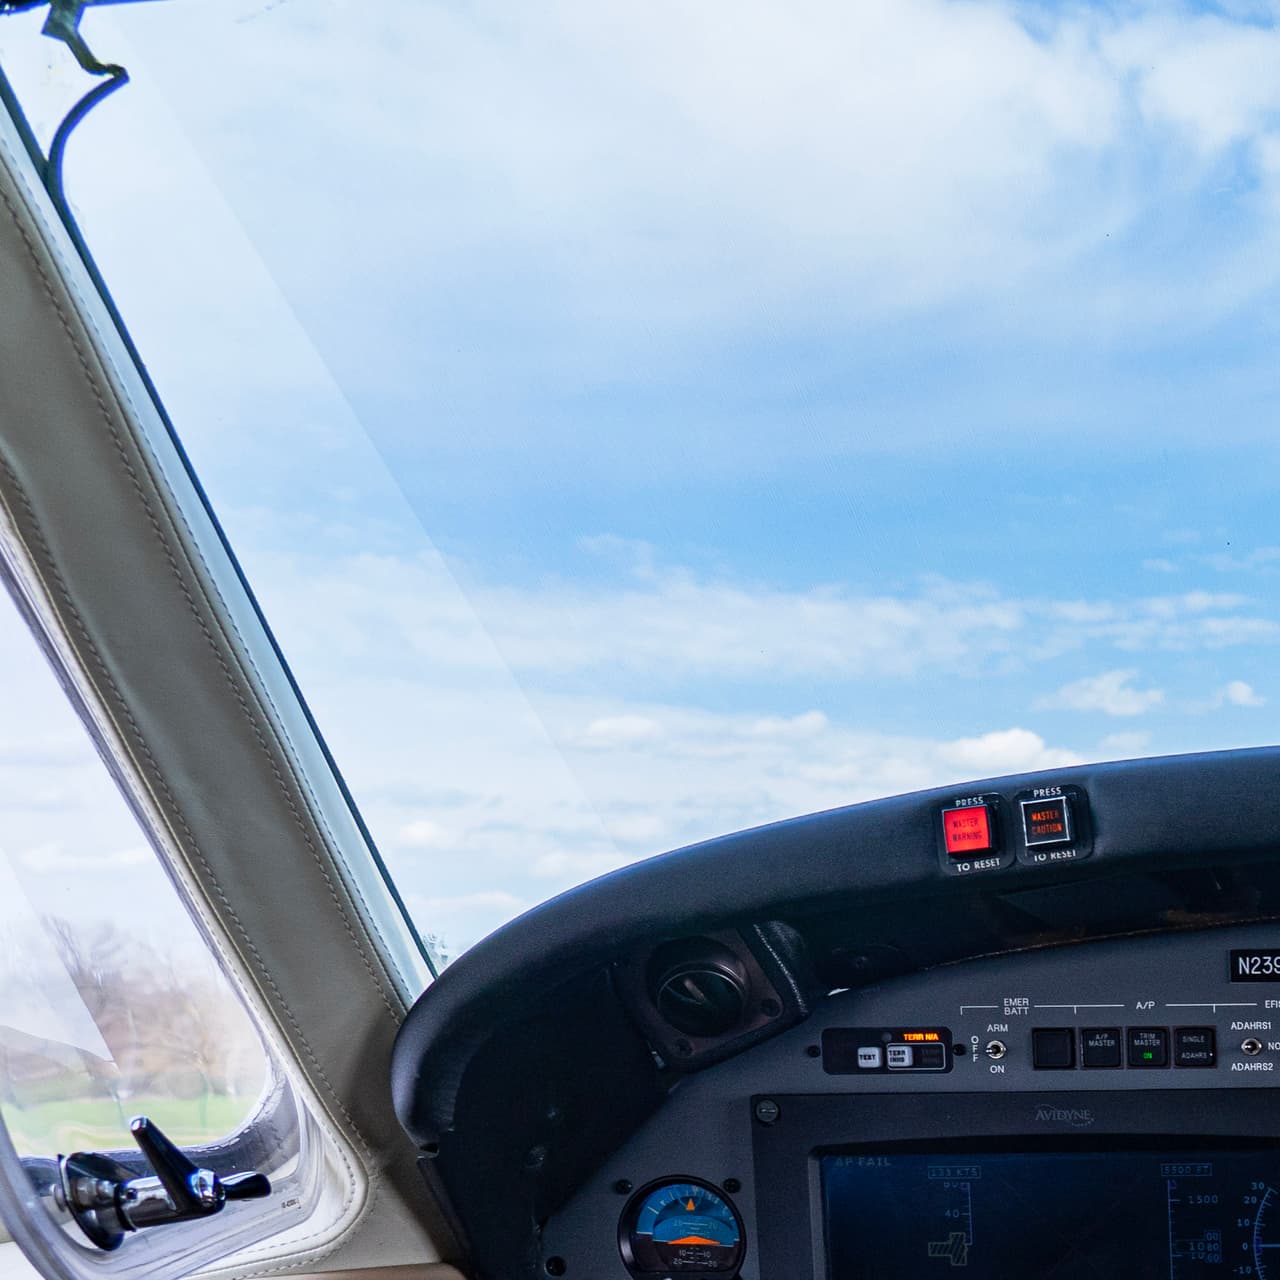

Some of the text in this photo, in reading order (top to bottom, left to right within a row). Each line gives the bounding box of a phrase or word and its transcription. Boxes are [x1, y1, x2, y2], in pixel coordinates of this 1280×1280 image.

[957, 858, 1001, 872] TO RESET
[1004, 998, 1029, 1007] EMER
[1136, 1001, 1155, 1009] A/P
[1004, 1007, 1029, 1015] BATT
[987, 1024, 1008, 1032] ARM
[1230, 1021, 1271, 1030] ADAHRS1
[1231, 1062, 1273, 1071] ADAHRS2
